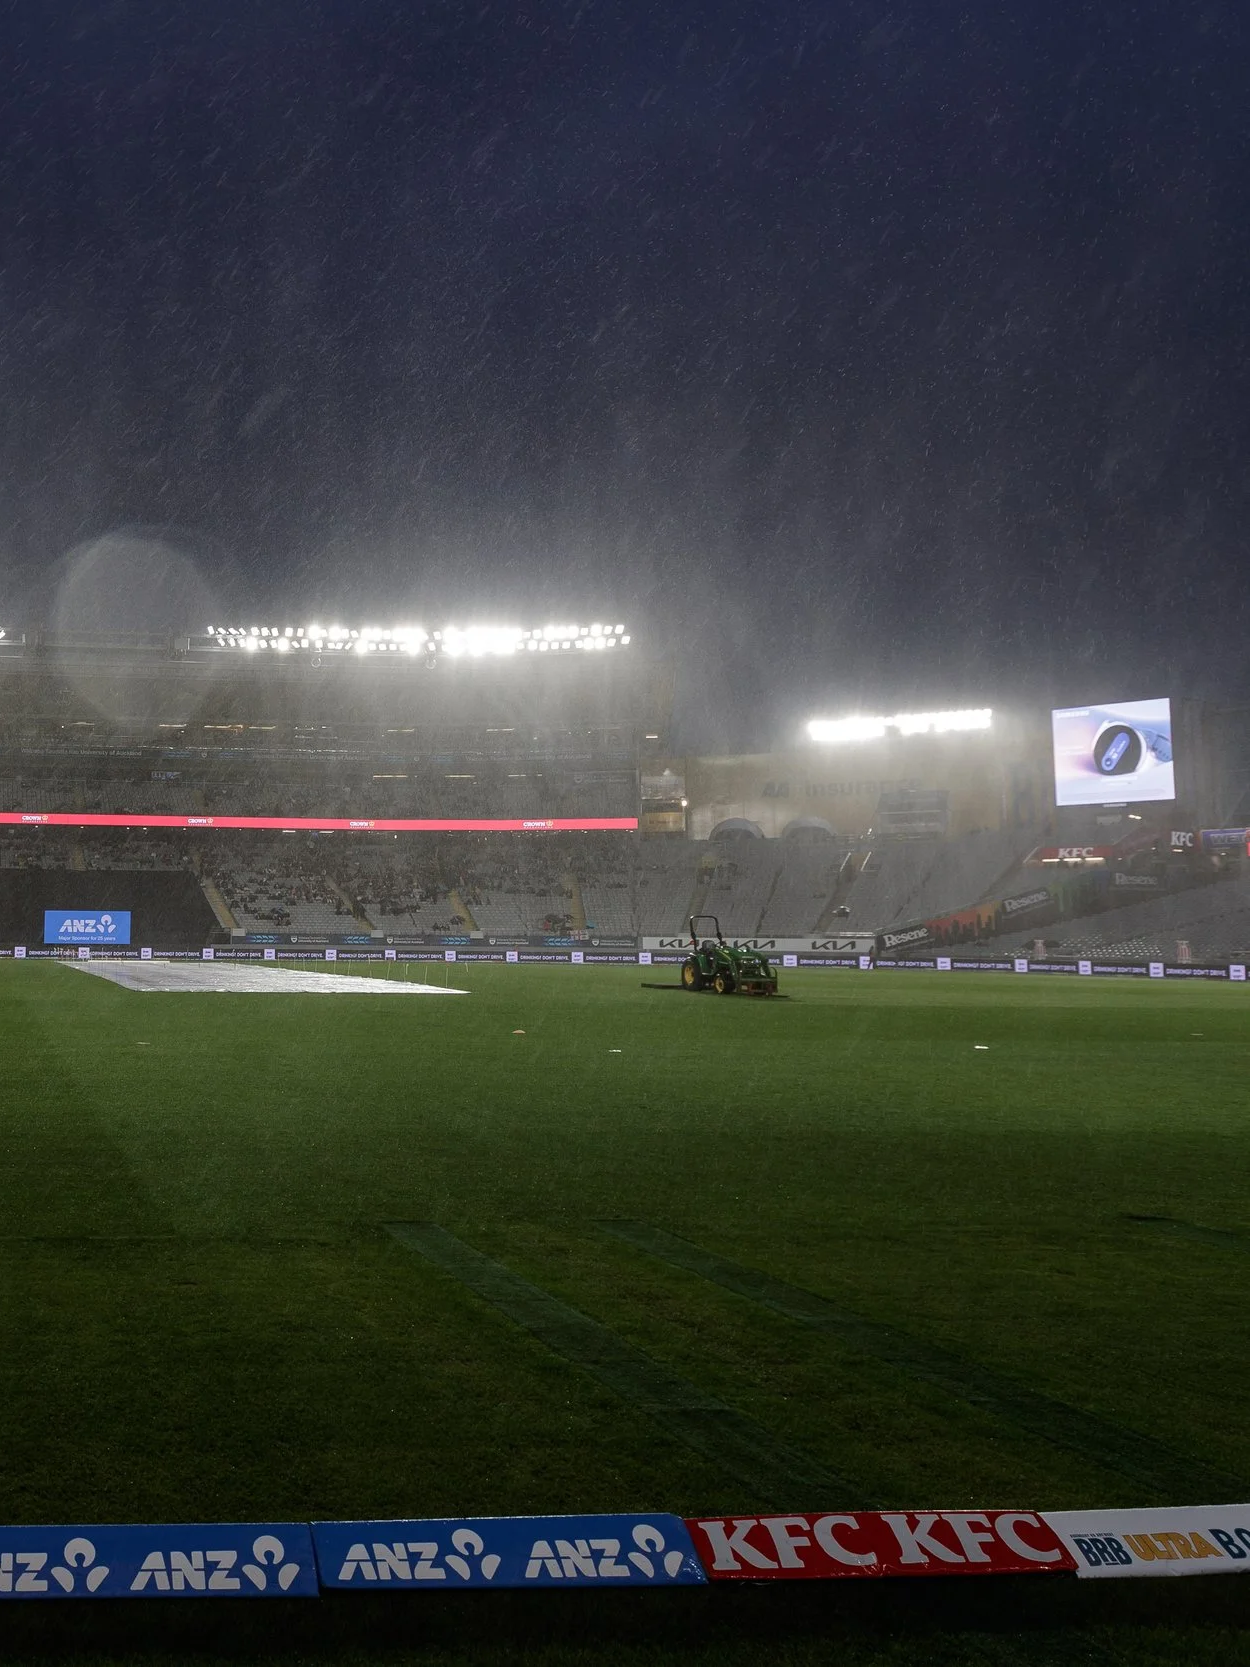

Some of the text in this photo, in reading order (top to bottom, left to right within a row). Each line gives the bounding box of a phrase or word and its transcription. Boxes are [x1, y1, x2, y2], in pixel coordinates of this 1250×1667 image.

[1170, 831, 1194, 847] KFC
[1057, 847, 1094, 858] KFC
[1115, 872, 1159, 886] Resene
[1003, 889, 1049, 913] Resene
[59, 919, 97, 933] ANZ
[733, 939, 776, 949] KIA
[811, 940, 856, 951] KIA
[882, 927, 929, 948] Resene
[698, 1513, 1062, 1571] KFC KFC
[1072, 1536, 1133, 1568] BRB
[1121, 1531, 1225, 1562] ULTRA
[337, 1538, 631, 1581] ANZ ANZ
[130, 1550, 242, 1591] ANZ
